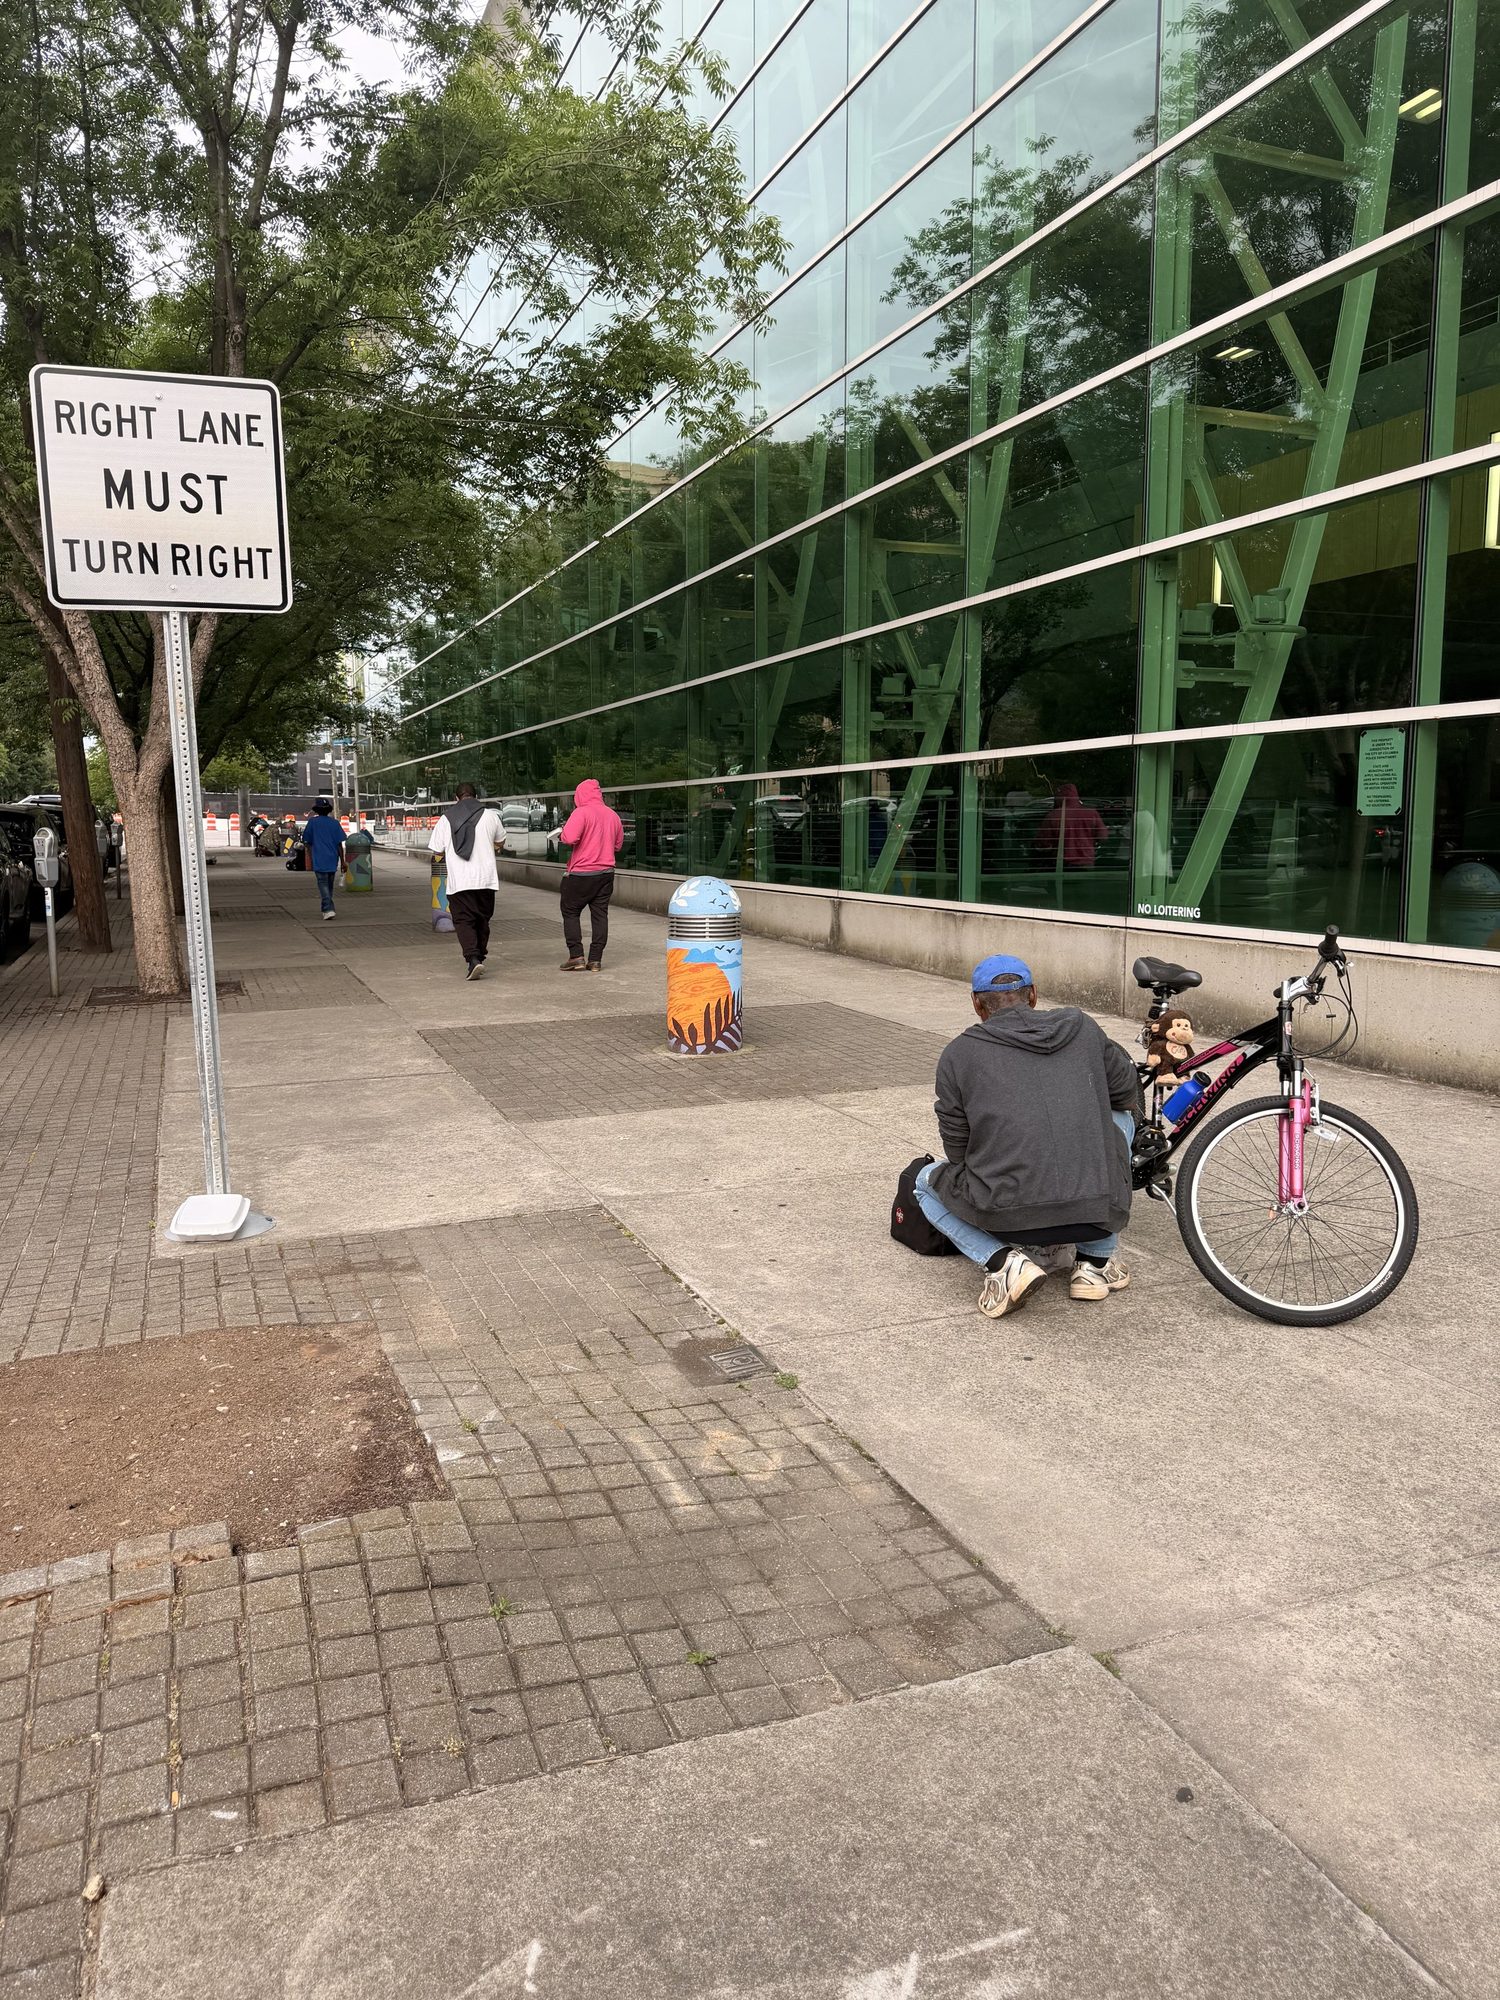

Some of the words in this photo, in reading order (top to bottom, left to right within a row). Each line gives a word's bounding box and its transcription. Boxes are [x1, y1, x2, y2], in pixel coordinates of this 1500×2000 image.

[54, 400, 157, 440] RIGHT
[178, 409, 264, 448] LANE
[103, 468, 228, 515] MUST
[62, 538, 160, 575] TURN
[170, 543, 273, 580] RIGHT
[1137, 903, 1151, 914] NO
[1153, 904, 1201, 918] LOITERING
